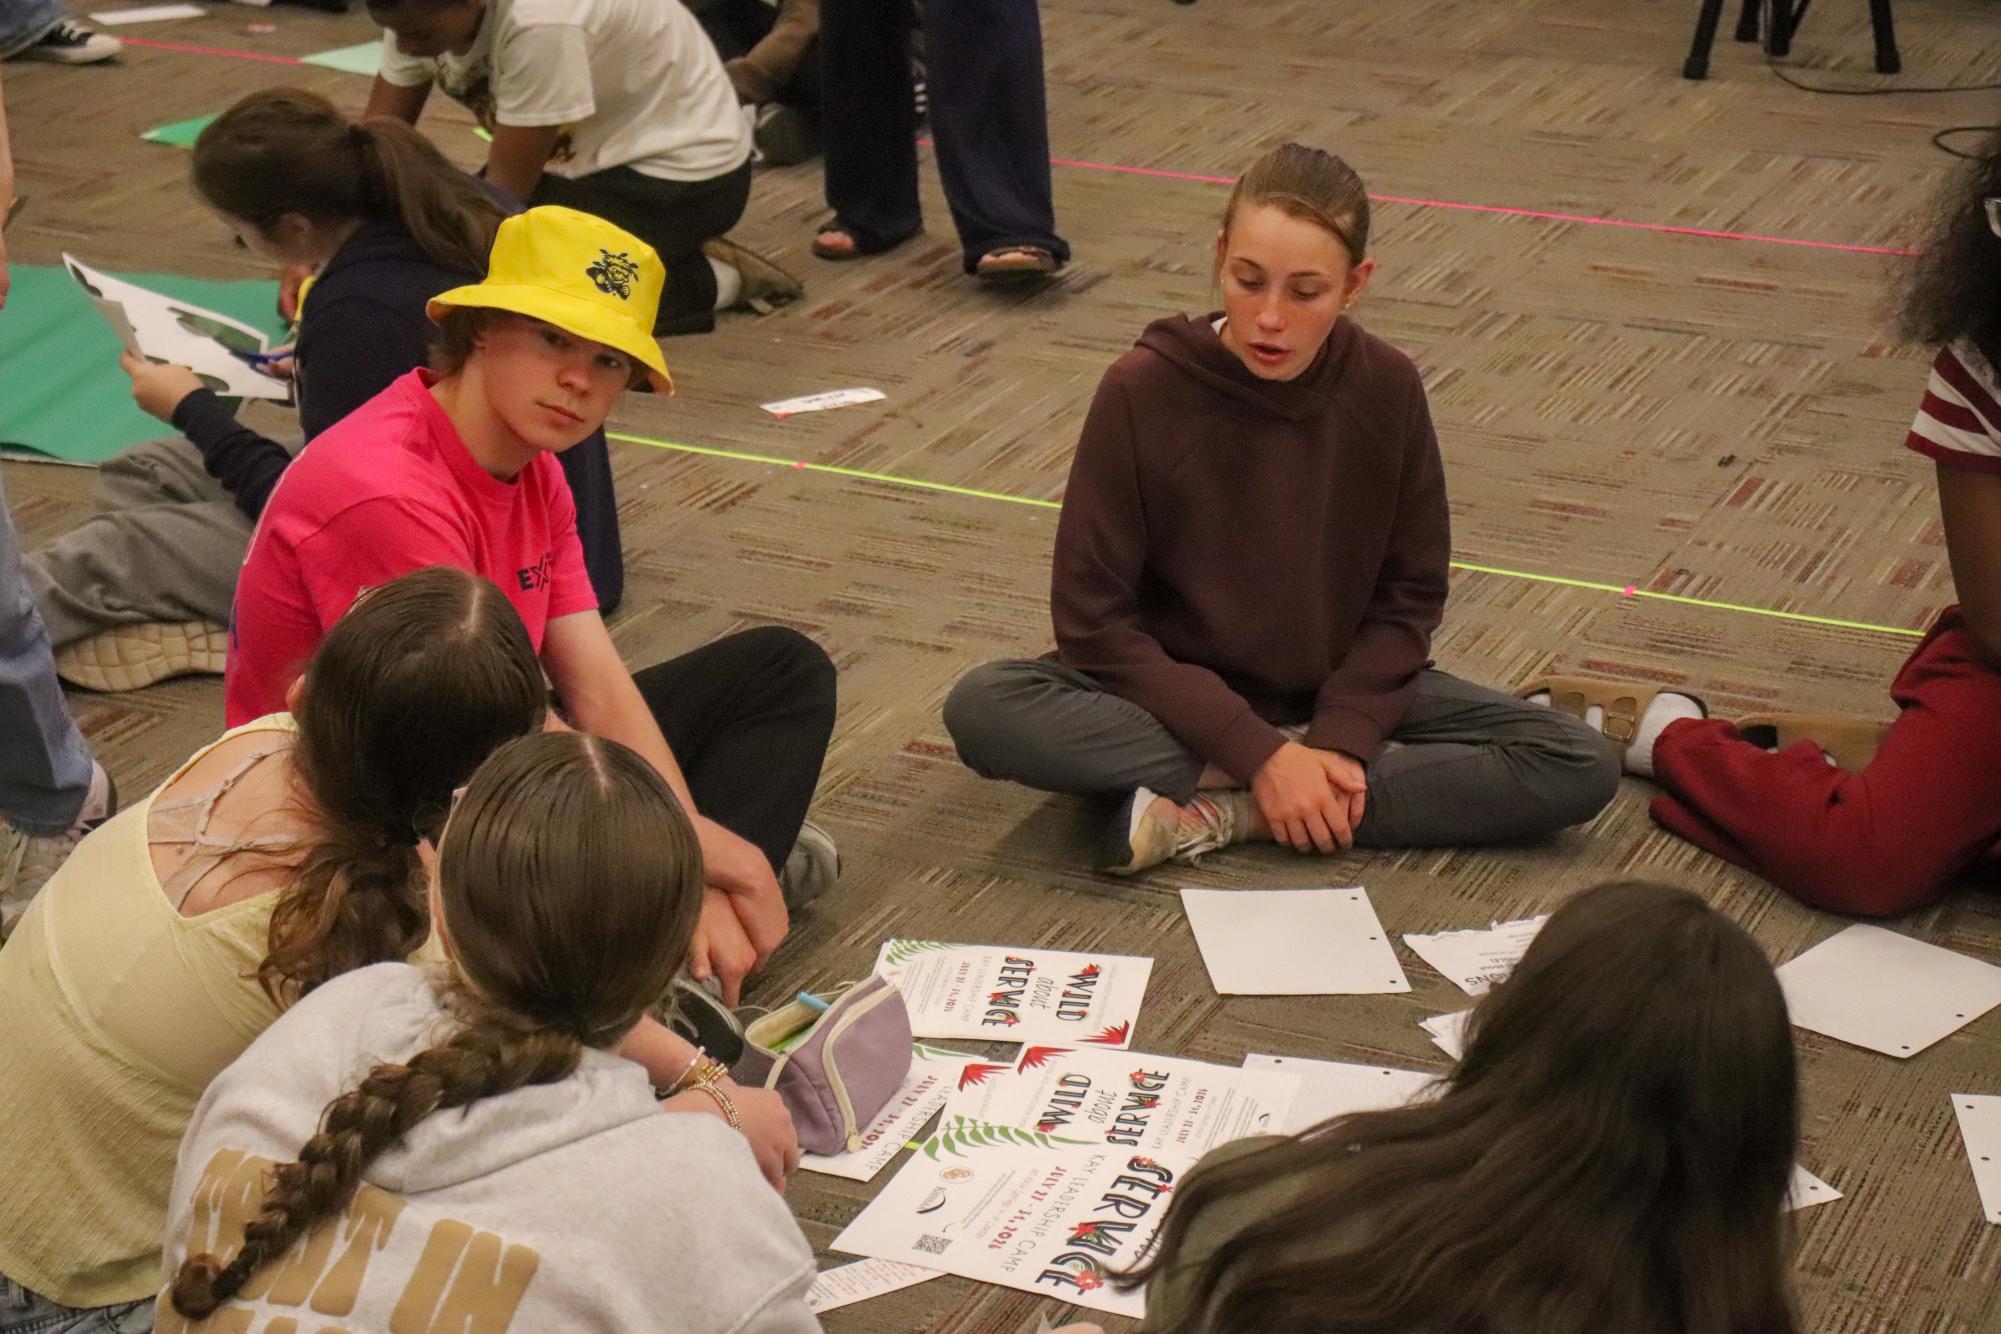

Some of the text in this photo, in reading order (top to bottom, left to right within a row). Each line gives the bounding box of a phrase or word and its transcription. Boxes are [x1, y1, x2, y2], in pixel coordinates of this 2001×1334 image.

[982, 956, 1035, 1027] SERVICE
[1030, 977, 1058, 1009] about
[1056, 965, 1102, 1022] WILD
[912, 1075, 939, 1096] JULY
[1036, 1073, 1092, 1131] WILD
[1088, 1089, 1117, 1124] about
[1104, 1068, 1170, 1146] SERVICE
[1176, 1128, 1190, 1144] JULY
[866, 1142, 901, 1171] CAMP
[1082, 1153, 1106, 1175] KAY
[1041, 1166, 1067, 1189] JULY
[1030, 1177, 1089, 1237] LEADERSHIP
[1031, 1190, 1048, 1202] 27
[1008, 1208, 1032, 1223] 31,
[1035, 1156, 1173, 1295] SERVICE
[988, 1225, 1018, 1250] 2026
[1001, 1240, 1036, 1273] CAMP
